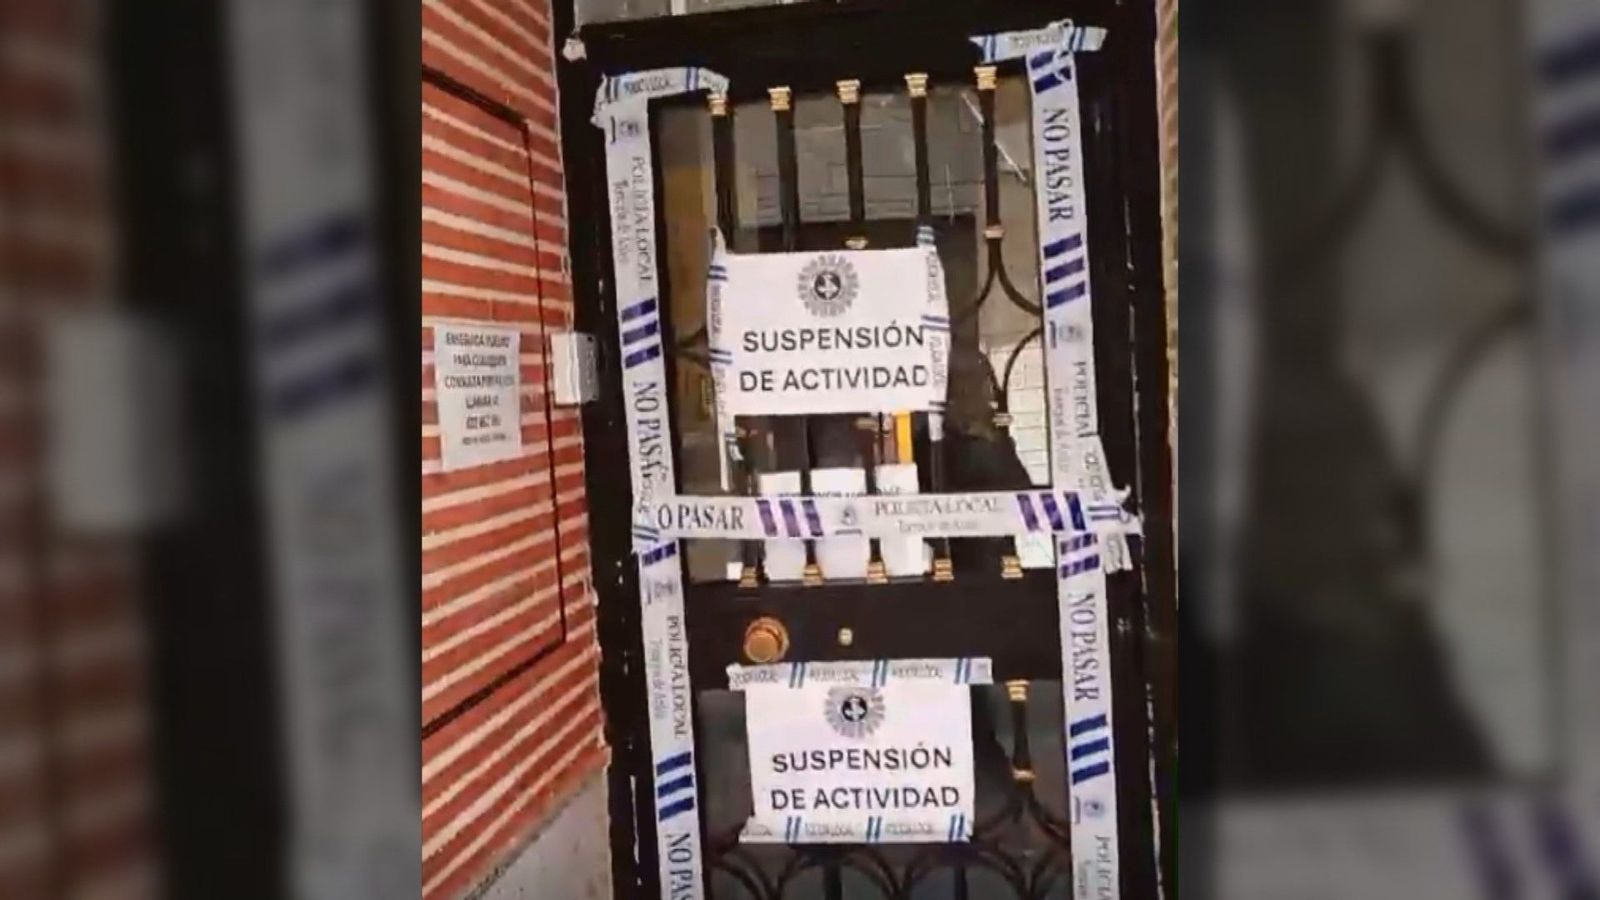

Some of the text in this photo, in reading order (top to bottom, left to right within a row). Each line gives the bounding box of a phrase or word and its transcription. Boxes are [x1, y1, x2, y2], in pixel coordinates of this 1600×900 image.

[1043, 108, 1073, 222] NO PASAR
[743, 320, 925, 352] SUSPENSIÓN
[740, 365, 929, 391] DE ACTIVIDAD
[633, 381, 660, 412] NO
[637, 418, 662, 478] PASA
[657, 503, 744, 530] O PASAR
[1068, 593, 1099, 701] NO PASAR
[772, 742, 952, 773] SUSPENSIÓN
[770, 786, 960, 810] DE ACTIVIDAD
[665, 833, 692, 862] NO
